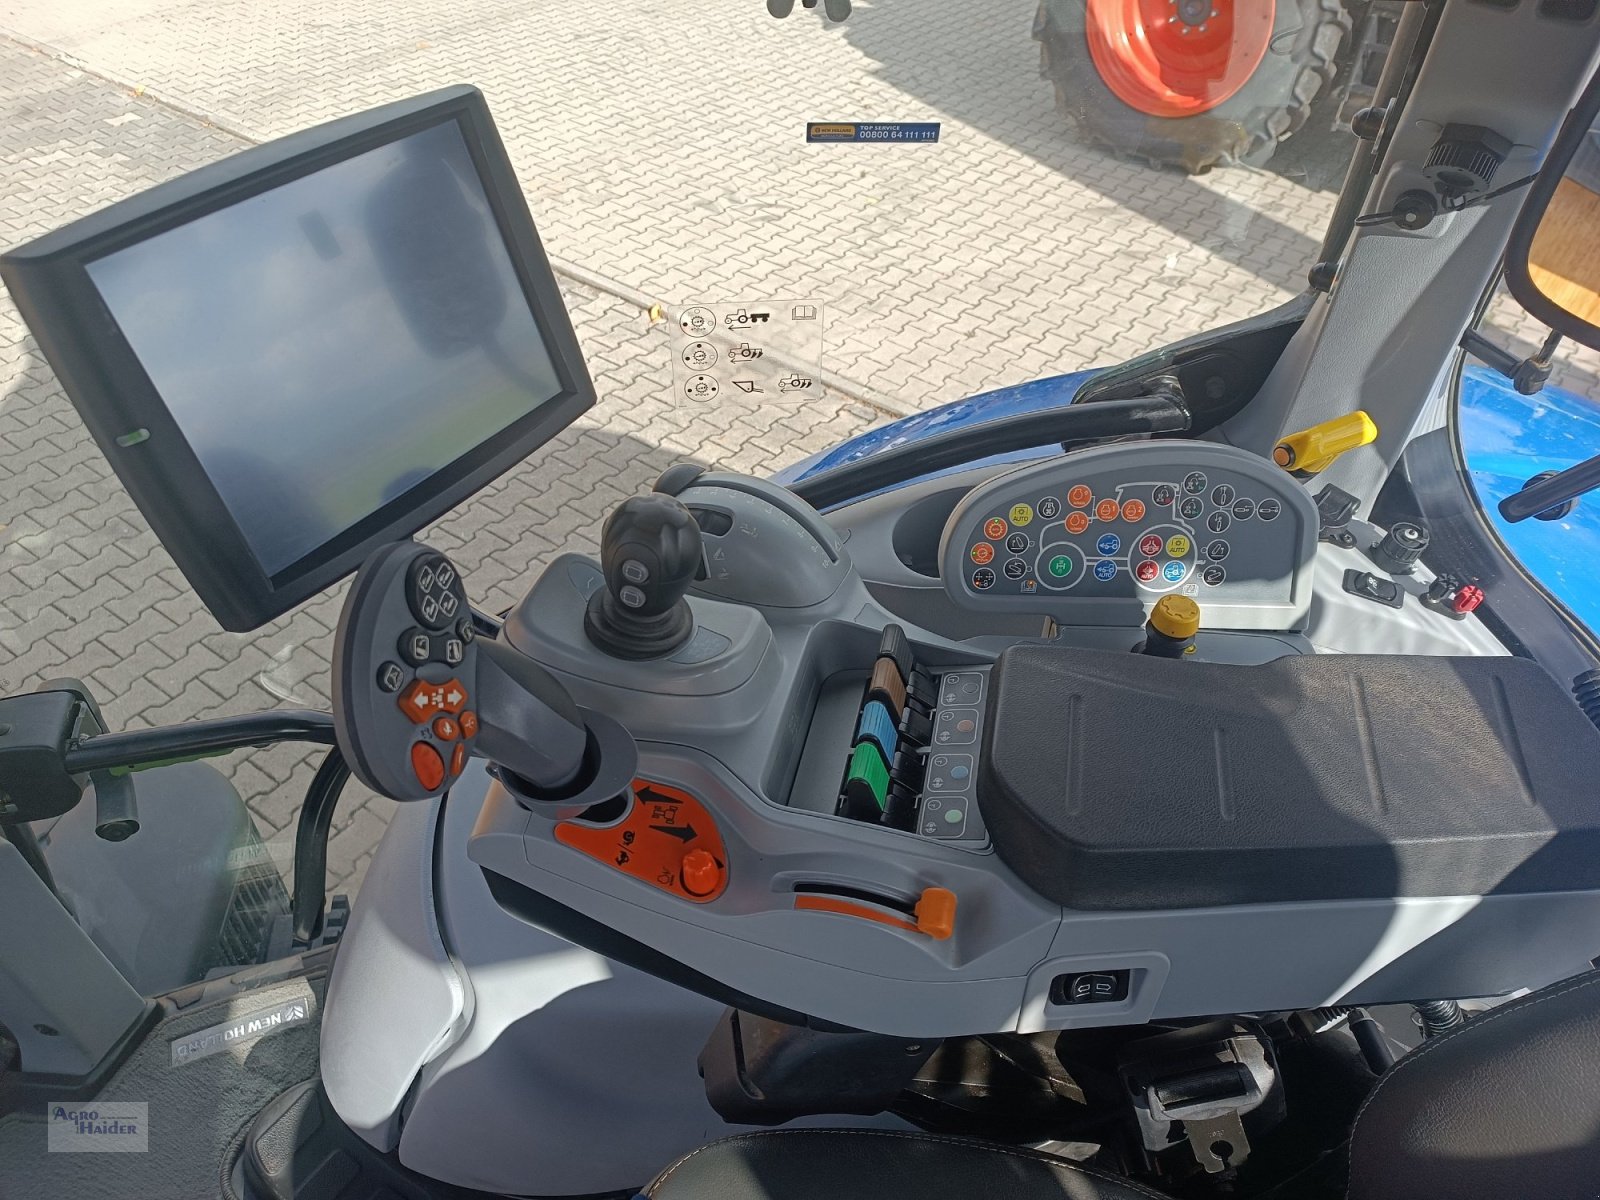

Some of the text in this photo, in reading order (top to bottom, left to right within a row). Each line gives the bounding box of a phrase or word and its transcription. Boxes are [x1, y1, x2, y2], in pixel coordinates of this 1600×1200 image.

[860, 131, 889, 139] 00800
[891, 131, 903, 139] 64
[905, 131, 918, 139] 111
[248, 1012, 281, 1033] NEW
